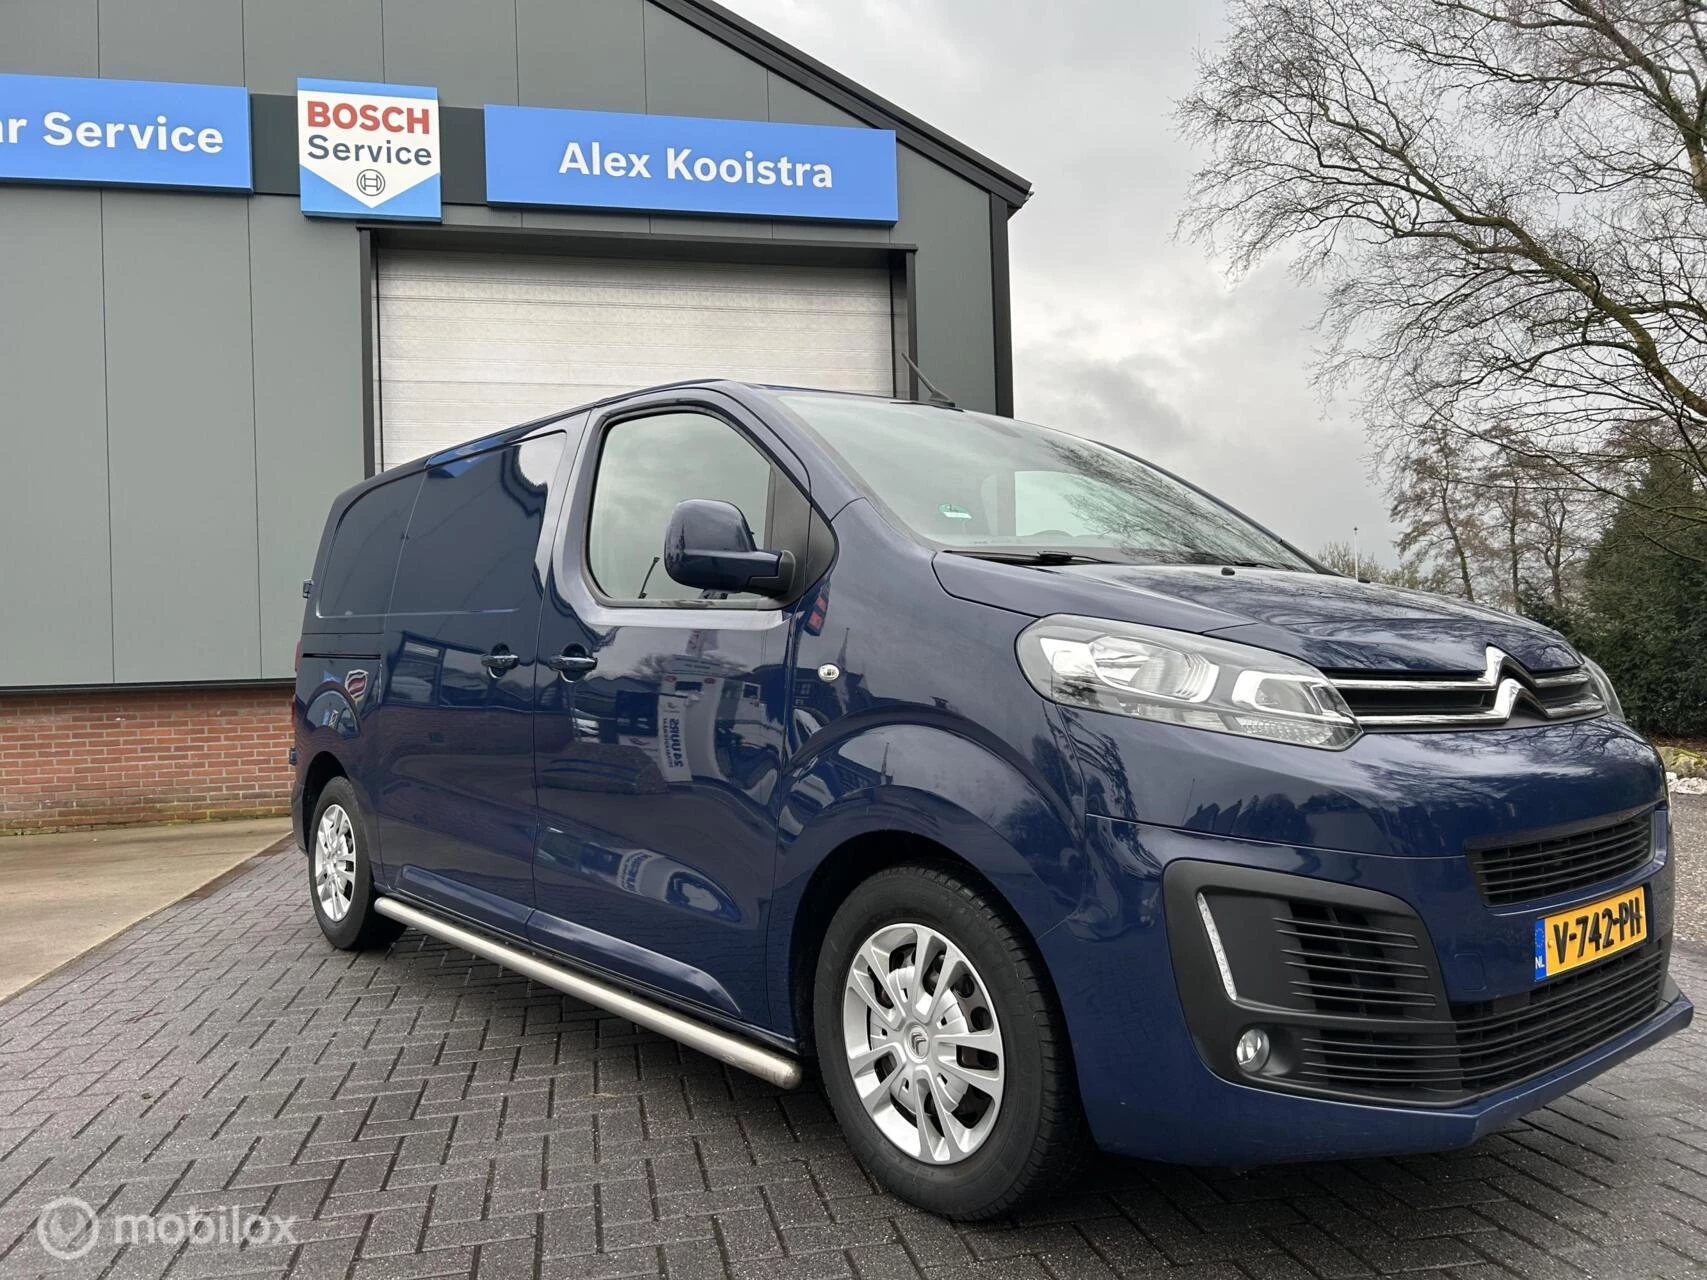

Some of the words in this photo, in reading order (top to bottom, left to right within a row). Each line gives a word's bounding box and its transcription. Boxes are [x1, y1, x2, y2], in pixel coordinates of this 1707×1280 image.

[0, 118, 28, 144] r
[43, 111, 224, 154] Service
[306, 100, 430, 134] BOSCH
[307, 134, 432, 166] Service
[559, 142, 652, 179] Alex
[666, 147, 833, 188] Kooistra
[1553, 897, 1642, 964] V-742-PH
[1535, 956, 1545, 969] NL
